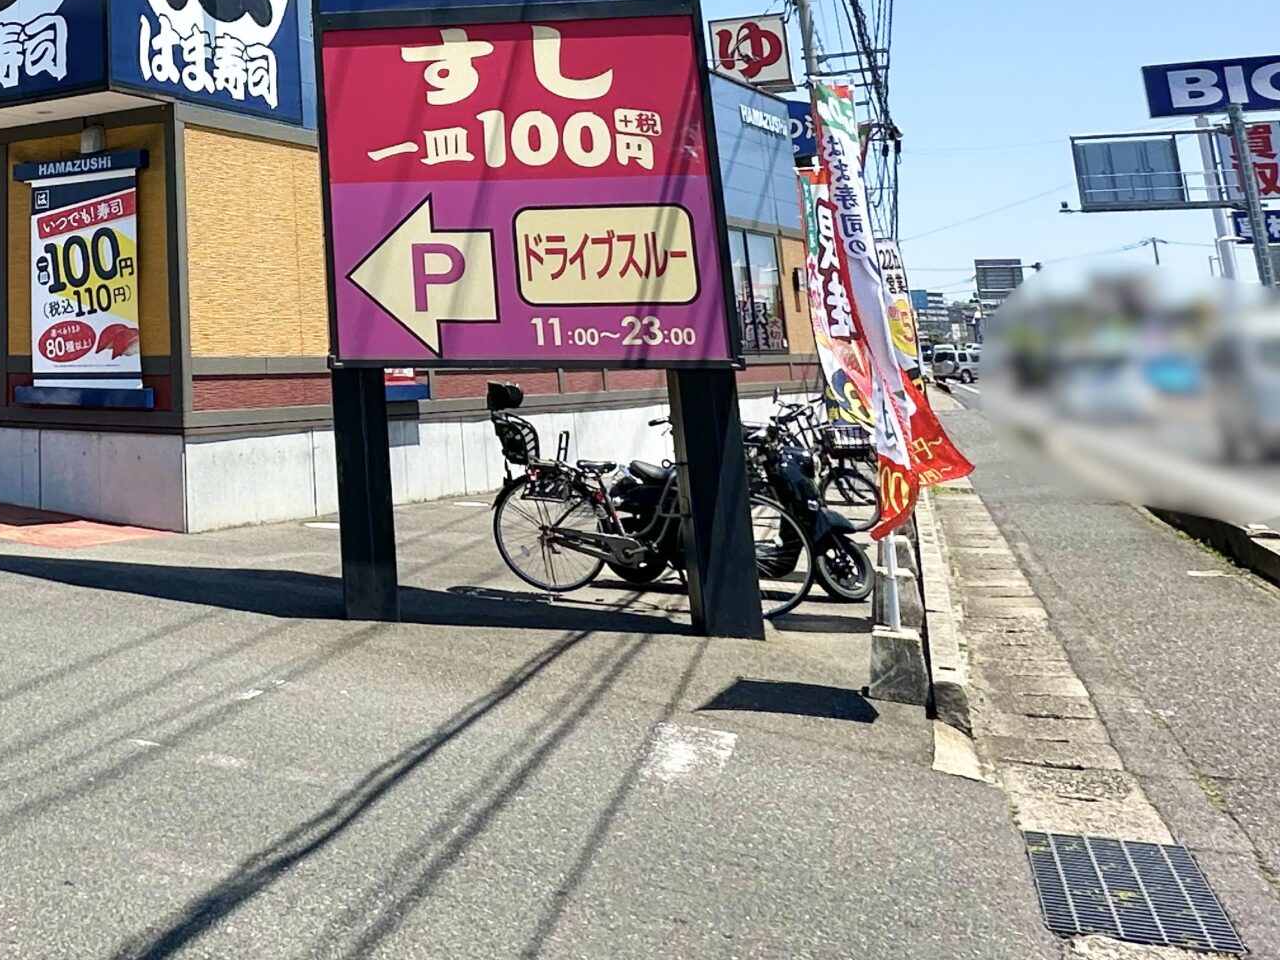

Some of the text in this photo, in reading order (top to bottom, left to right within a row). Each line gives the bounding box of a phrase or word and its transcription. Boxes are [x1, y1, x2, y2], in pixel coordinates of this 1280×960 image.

[139, 14, 279, 109] はま寿司
[401, 25, 613, 106] すし
[715, 21, 783, 79] ゆ
[411, 242, 466, 313] P
[523, 229, 688, 282] ドライブスルー
